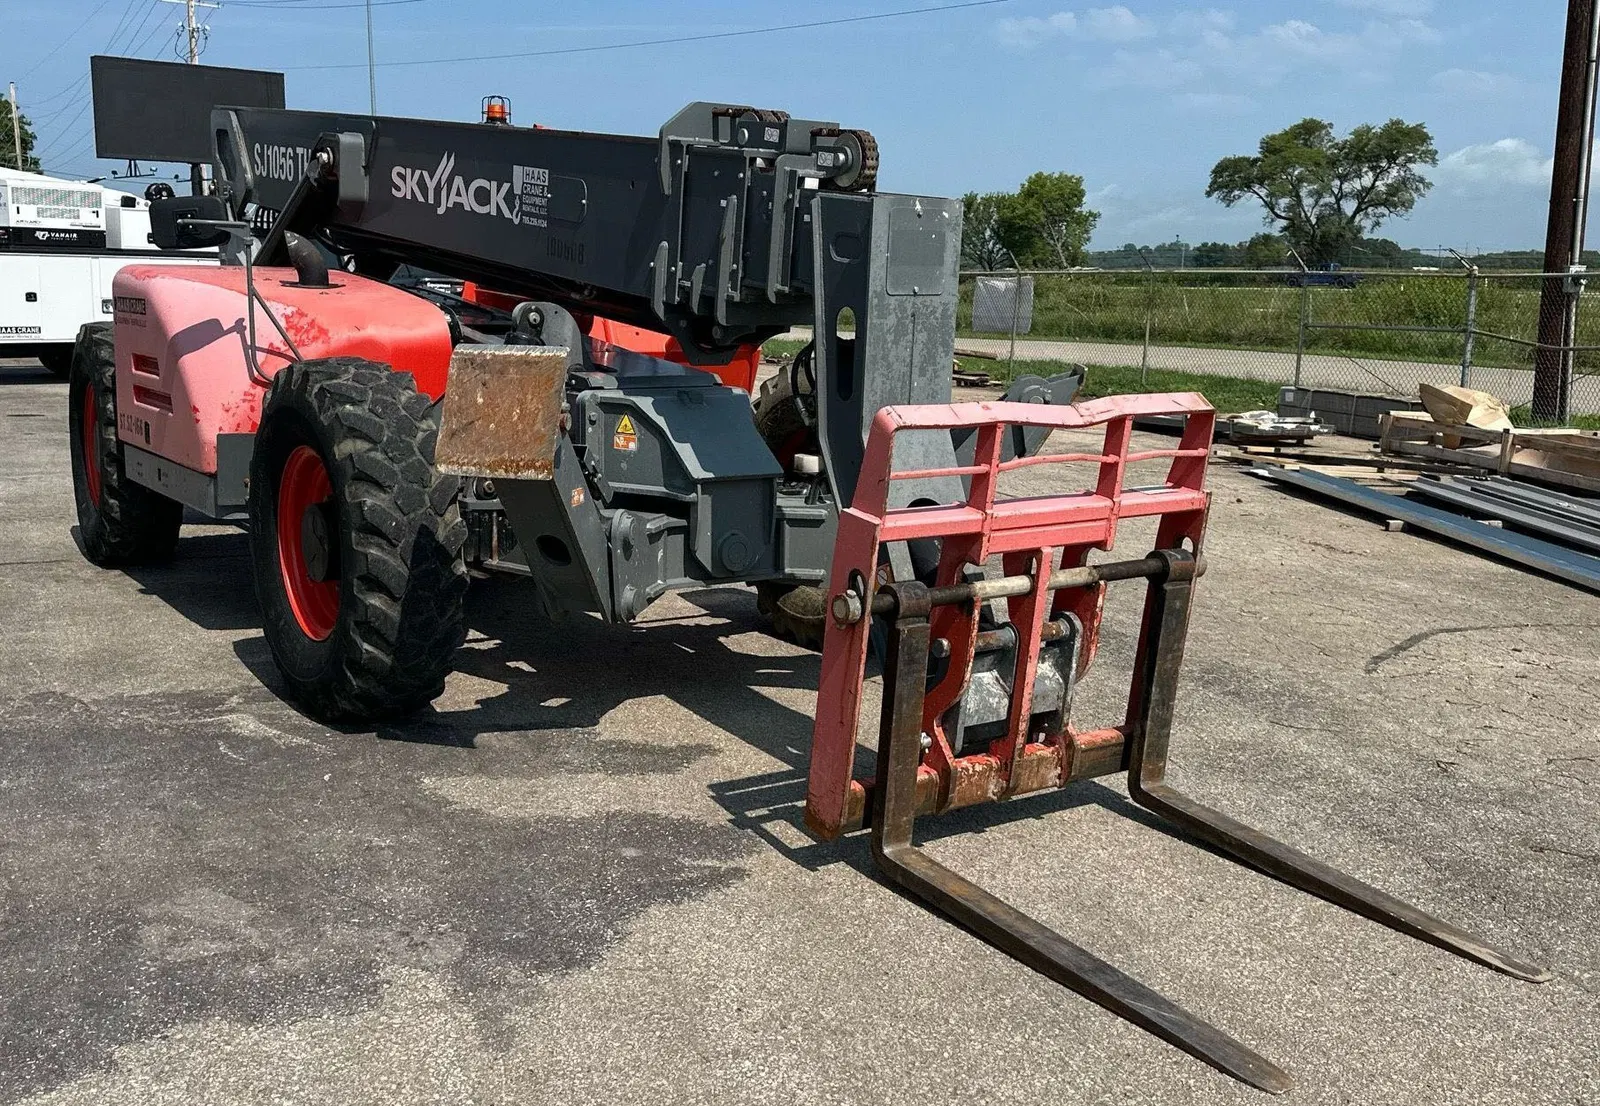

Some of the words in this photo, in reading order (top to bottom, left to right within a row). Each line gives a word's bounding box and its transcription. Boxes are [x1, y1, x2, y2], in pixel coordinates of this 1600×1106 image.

[254, 143, 294, 182] SJ1056
[525, 168, 547, 184] HAAS
[391, 151, 513, 219] SKYJACK
[523, 183, 543, 196] CRANE
[522, 195, 547, 206] EQUIPMENT
